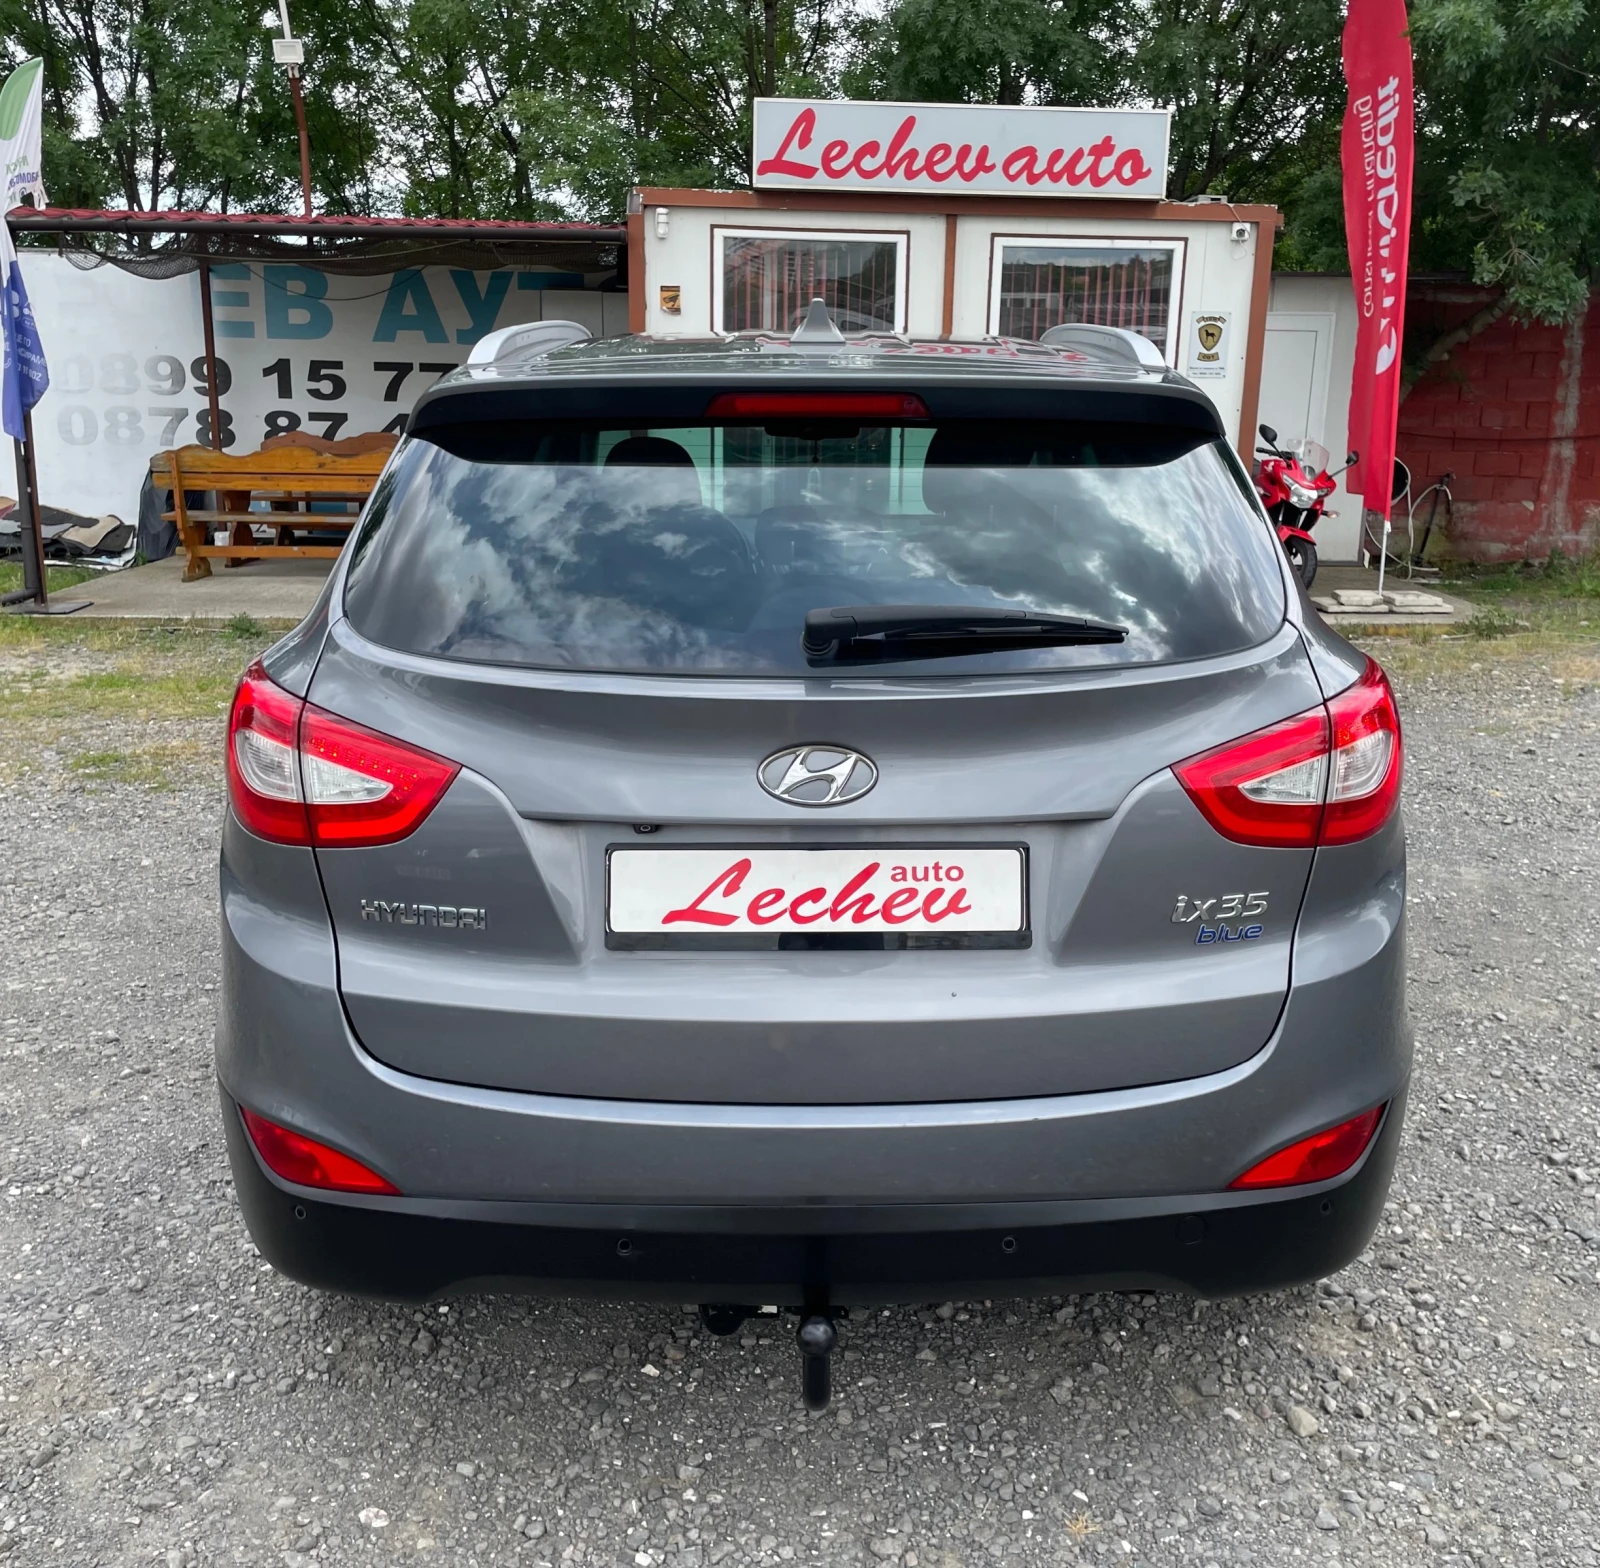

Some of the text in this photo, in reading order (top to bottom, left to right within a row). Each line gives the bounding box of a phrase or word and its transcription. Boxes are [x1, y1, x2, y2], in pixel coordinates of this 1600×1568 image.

[757, 108, 1153, 188] Lechev auto
[53, 352, 232, 397] 0899
[262, 358, 347, 401] 15
[57, 405, 236, 448] 0878
[890, 860, 965, 882] auto
[661, 858, 972, 927] Lechev
[1171, 891, 1270, 923] ix35
[360, 899, 487, 930] HYUNDAI
[1195, 923, 1264, 945] blue
